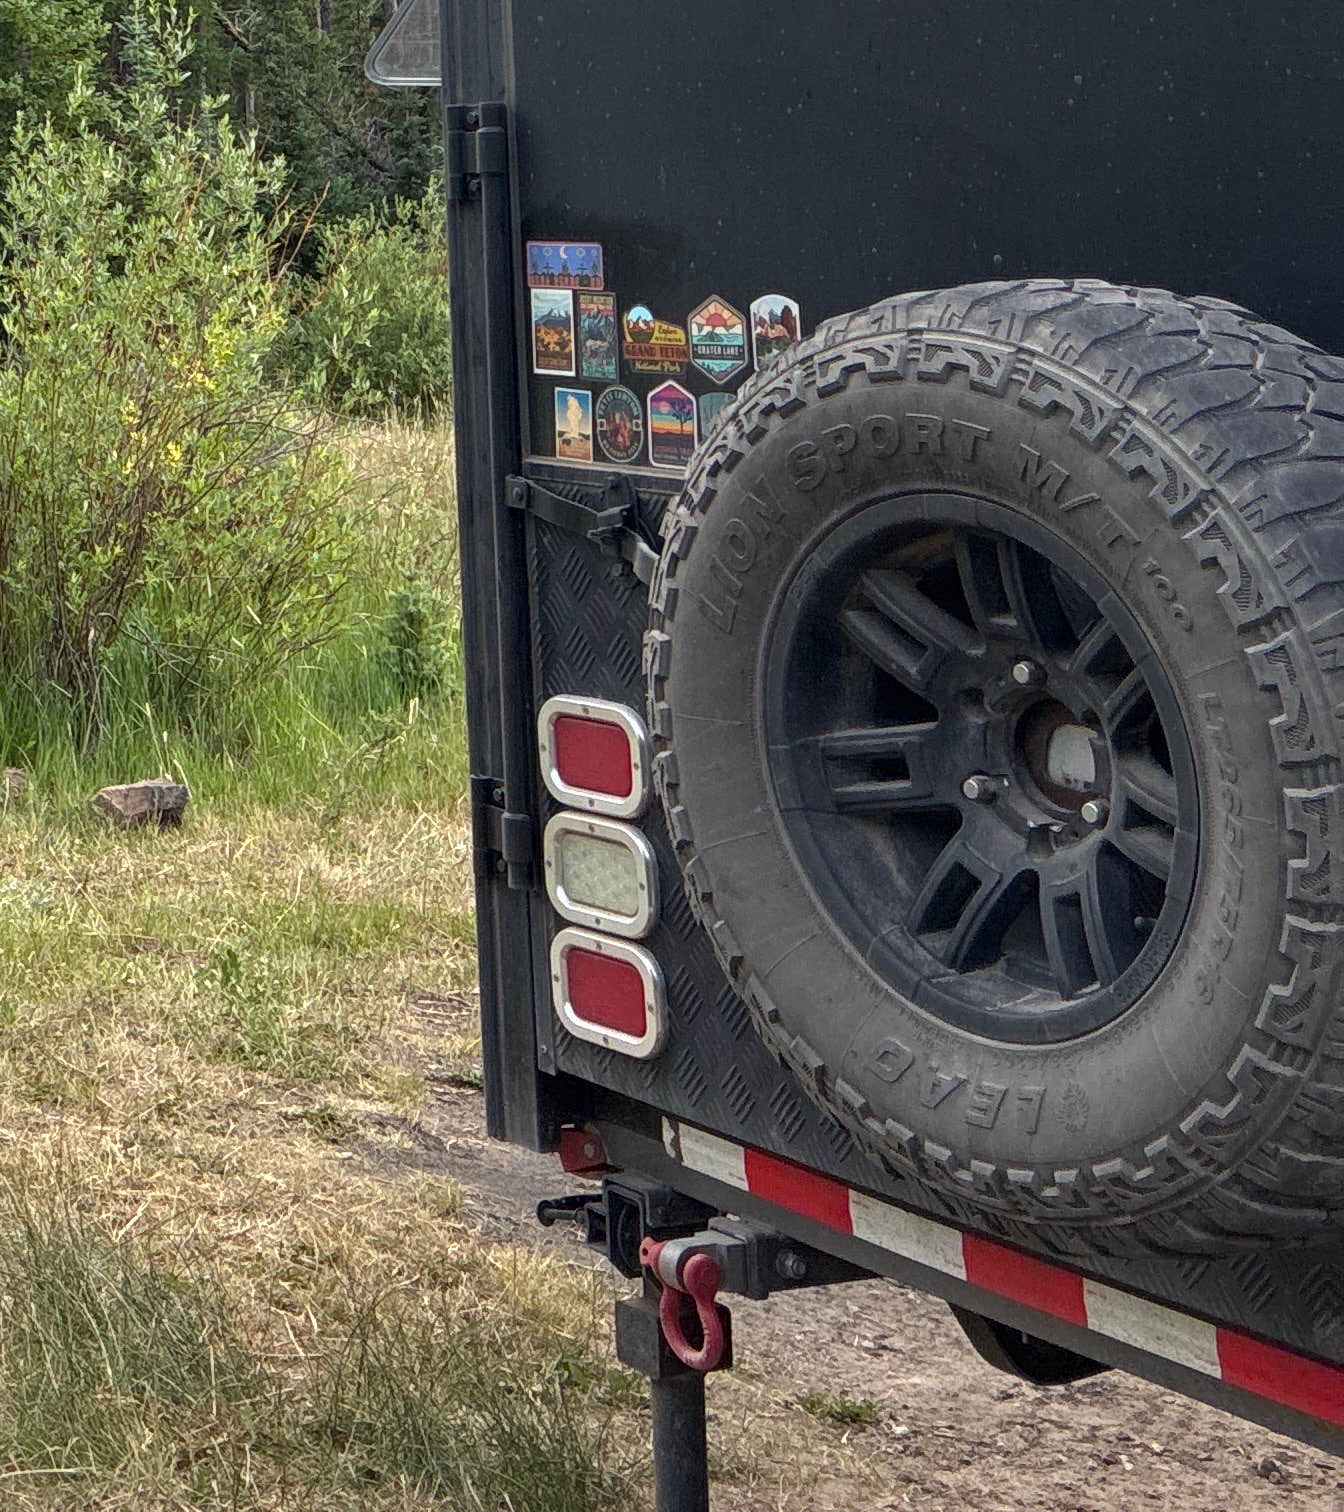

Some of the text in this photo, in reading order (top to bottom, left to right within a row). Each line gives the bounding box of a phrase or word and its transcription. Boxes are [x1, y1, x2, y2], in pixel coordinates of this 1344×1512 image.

[697, 346, 739, 356] CRATER LAKE
[696, 478, 787, 634] LION
[786, 412, 992, 490] SPORT
[1016, 442, 1142, 548] M/T
